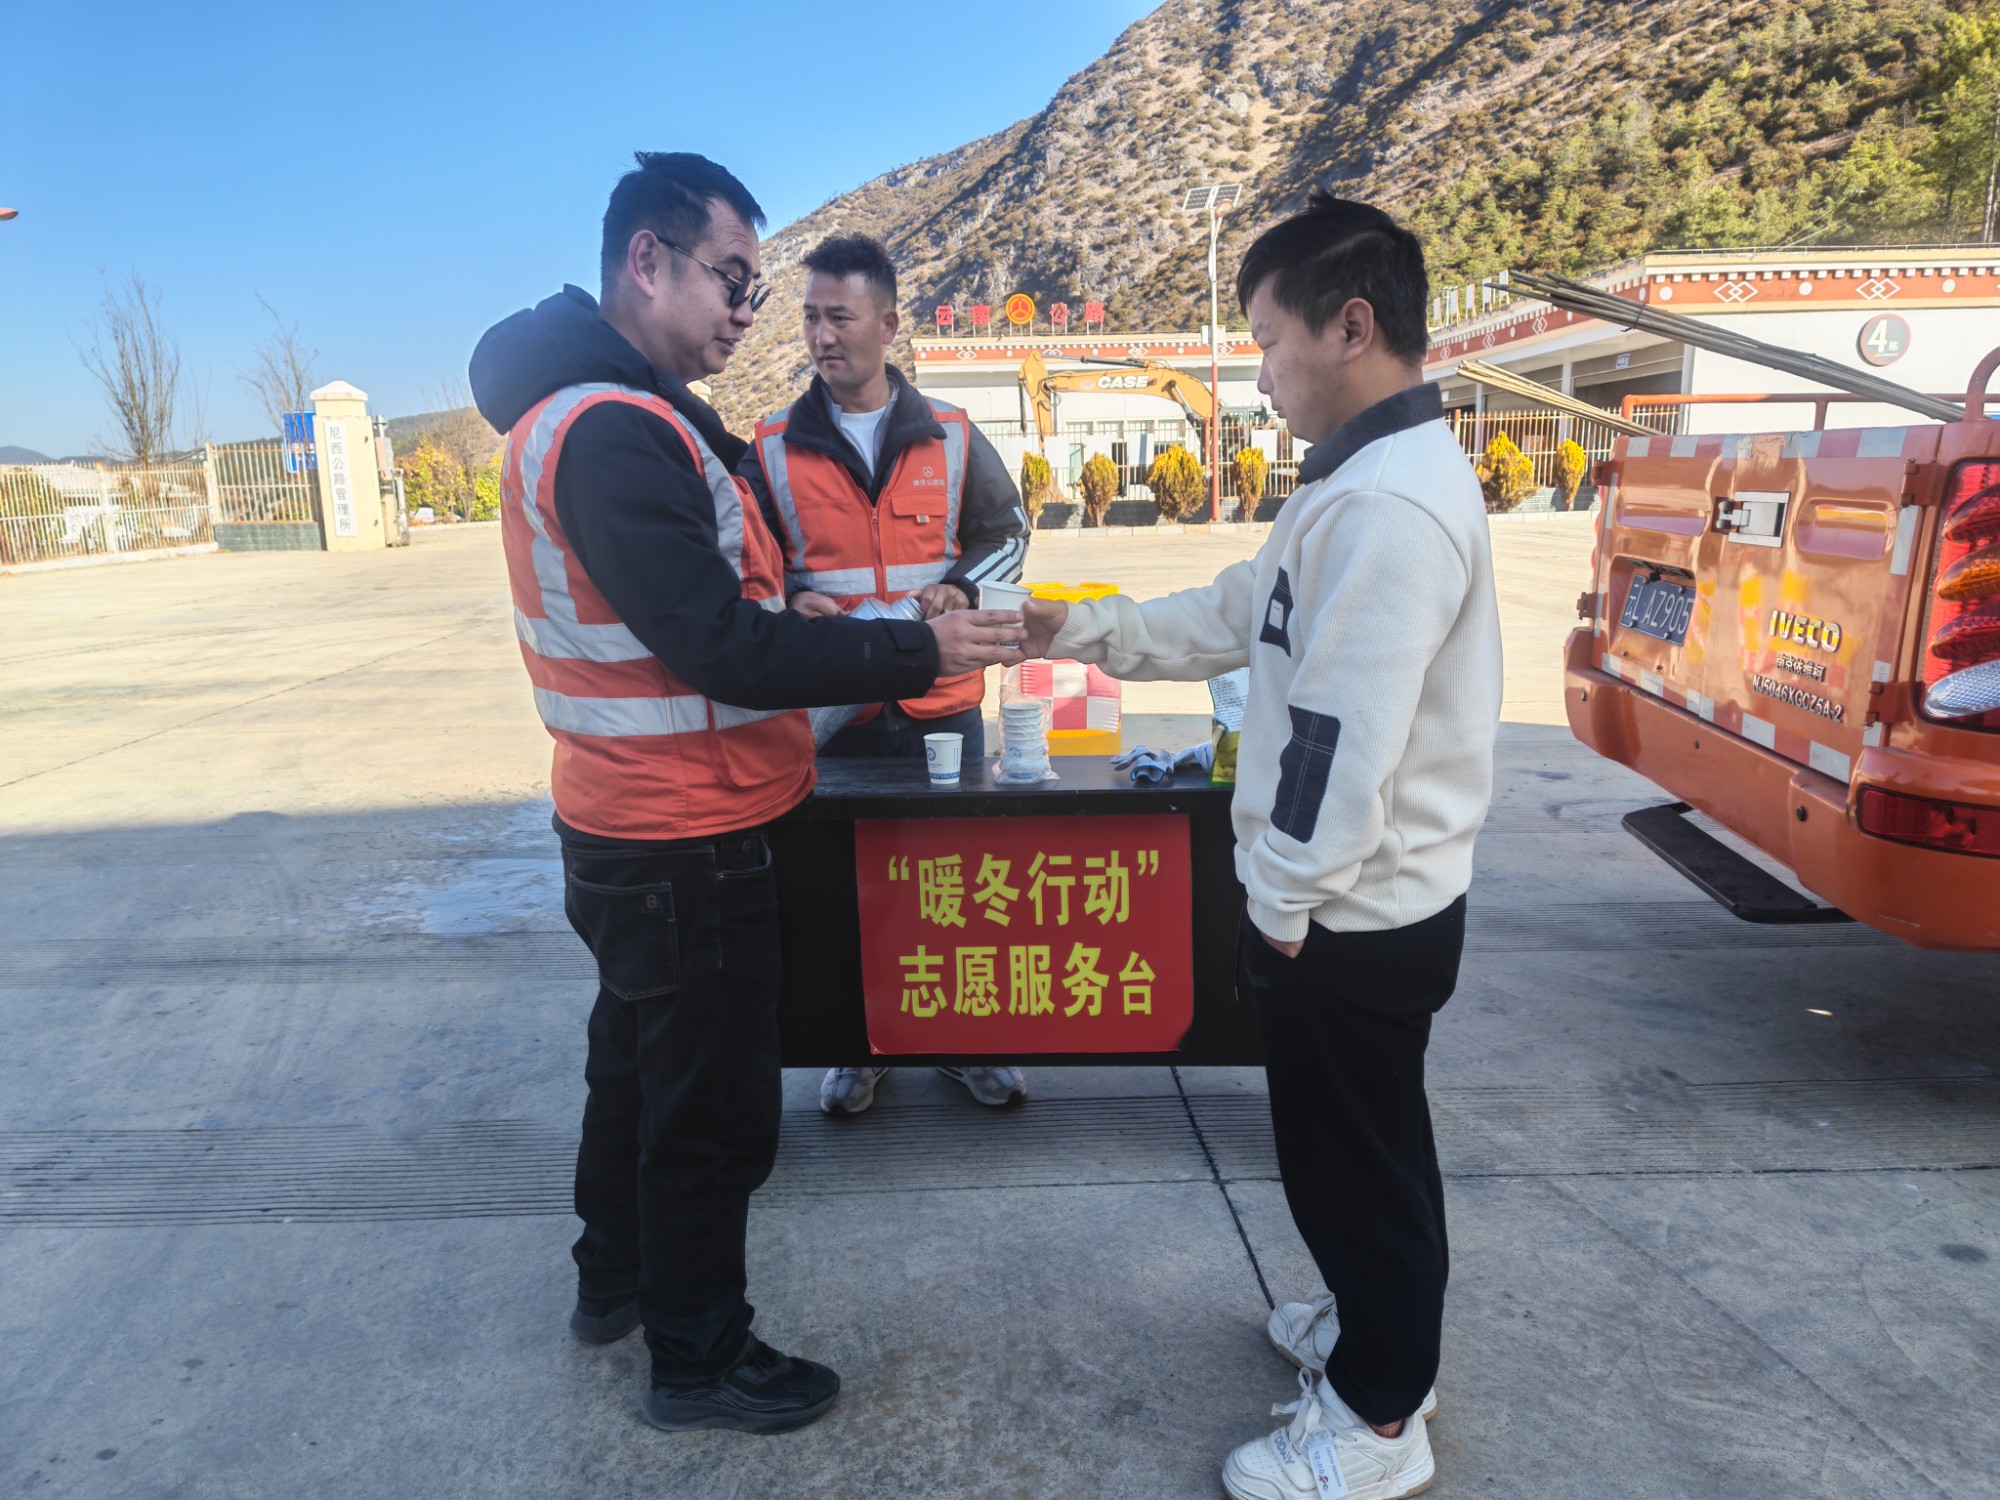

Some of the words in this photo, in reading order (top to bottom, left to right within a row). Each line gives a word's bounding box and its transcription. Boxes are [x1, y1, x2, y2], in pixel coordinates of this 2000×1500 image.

[1097, 375, 1149, 389] CASE
[329, 426, 351, 531] 尼西公路管理所
[1768, 610, 1841, 653] IVECO
[1776, 653, 1826, 682] 南京依维柯
[1752, 674, 1844, 723] NJ5046XGCZ5A-2
[888, 850, 1159, 928] “暖冬行动”
[899, 942, 1156, 1018] 志愿服务台
[1273, 1430, 1295, 1465] TODAY
